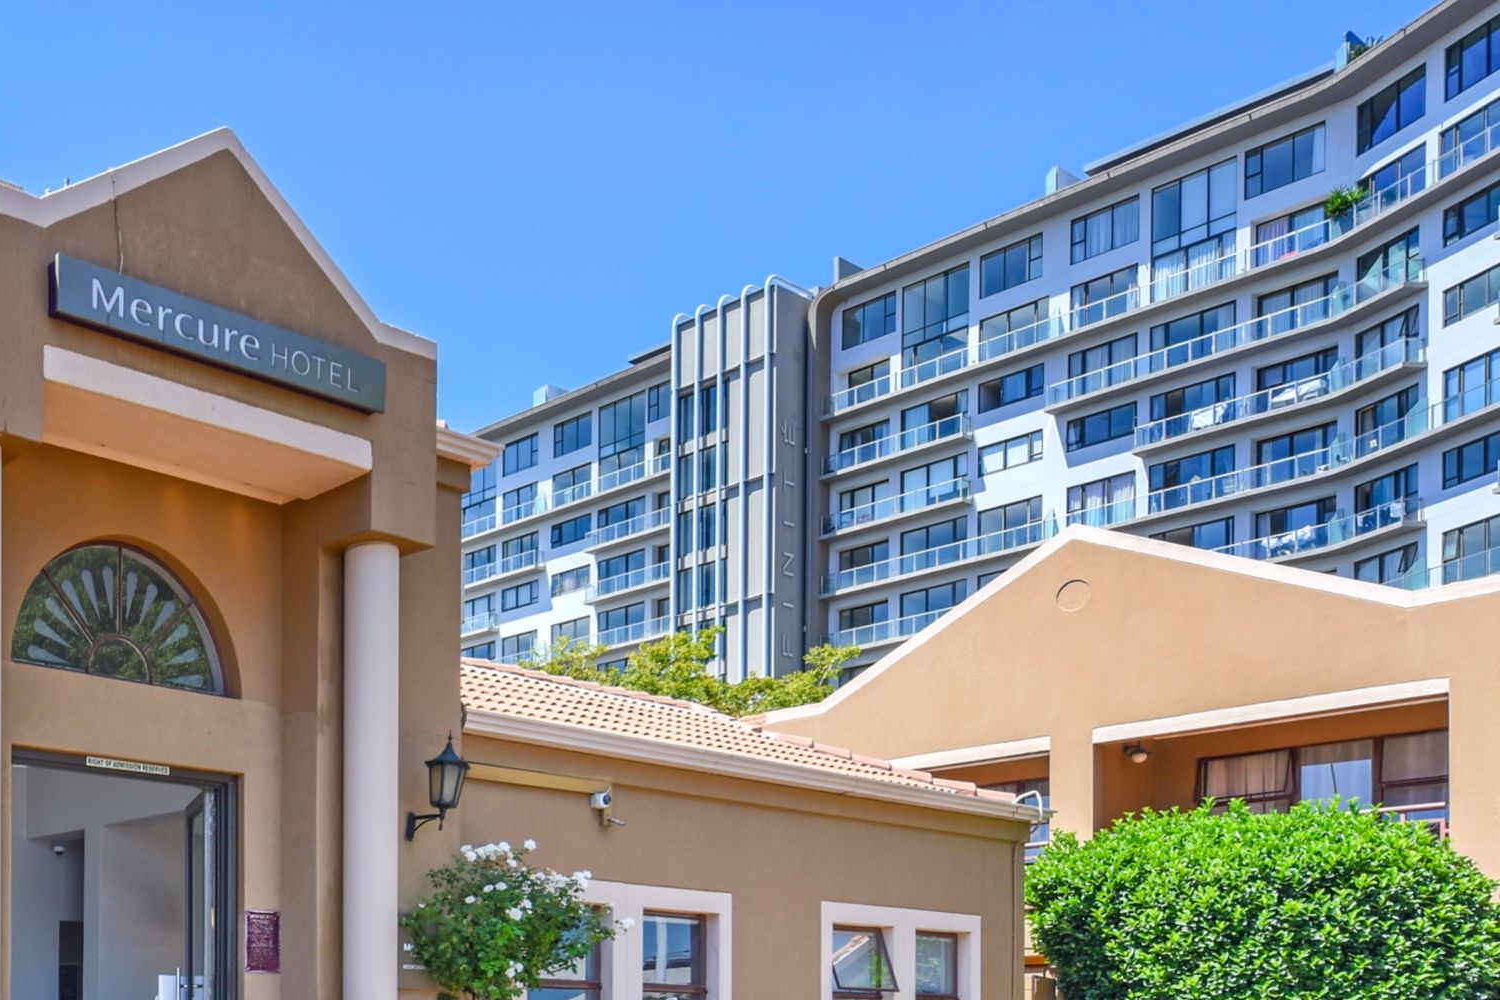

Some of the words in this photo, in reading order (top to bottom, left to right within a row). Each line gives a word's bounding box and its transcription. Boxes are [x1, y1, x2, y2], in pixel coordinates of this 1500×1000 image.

[91, 277, 261, 361] Mercure
[270, 342, 360, 394] HOTEL
[88, 757, 104, 766] RIGHT
[113, 761, 141, 770] ADMISSION
[142, 764, 168, 774] RESERVED
